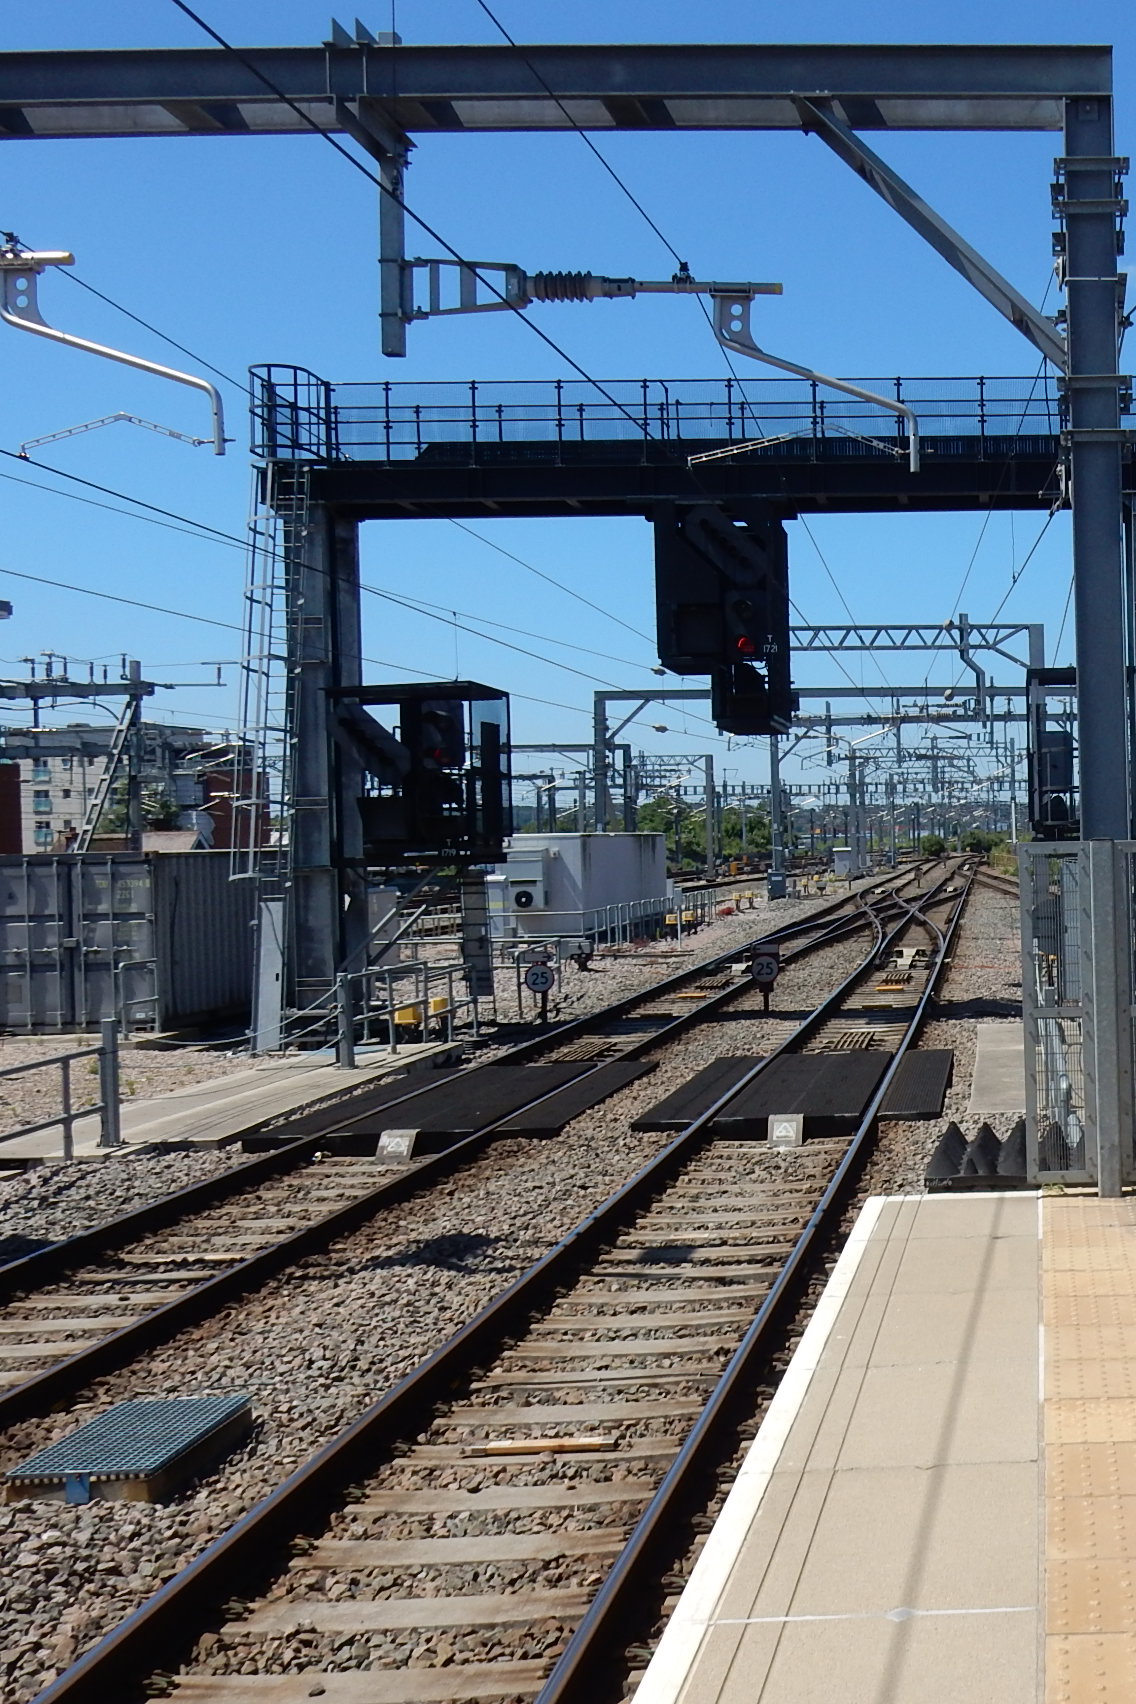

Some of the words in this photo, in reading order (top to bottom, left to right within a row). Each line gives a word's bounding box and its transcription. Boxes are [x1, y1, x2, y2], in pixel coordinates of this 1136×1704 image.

[767, 634, 773, 643] T
[763, 644, 778, 653] 1721
[445, 838, 451, 847] T
[441, 848, 457, 857] 1719
[756, 961, 774, 976] 25
[531, 971, 549, 986] 25
